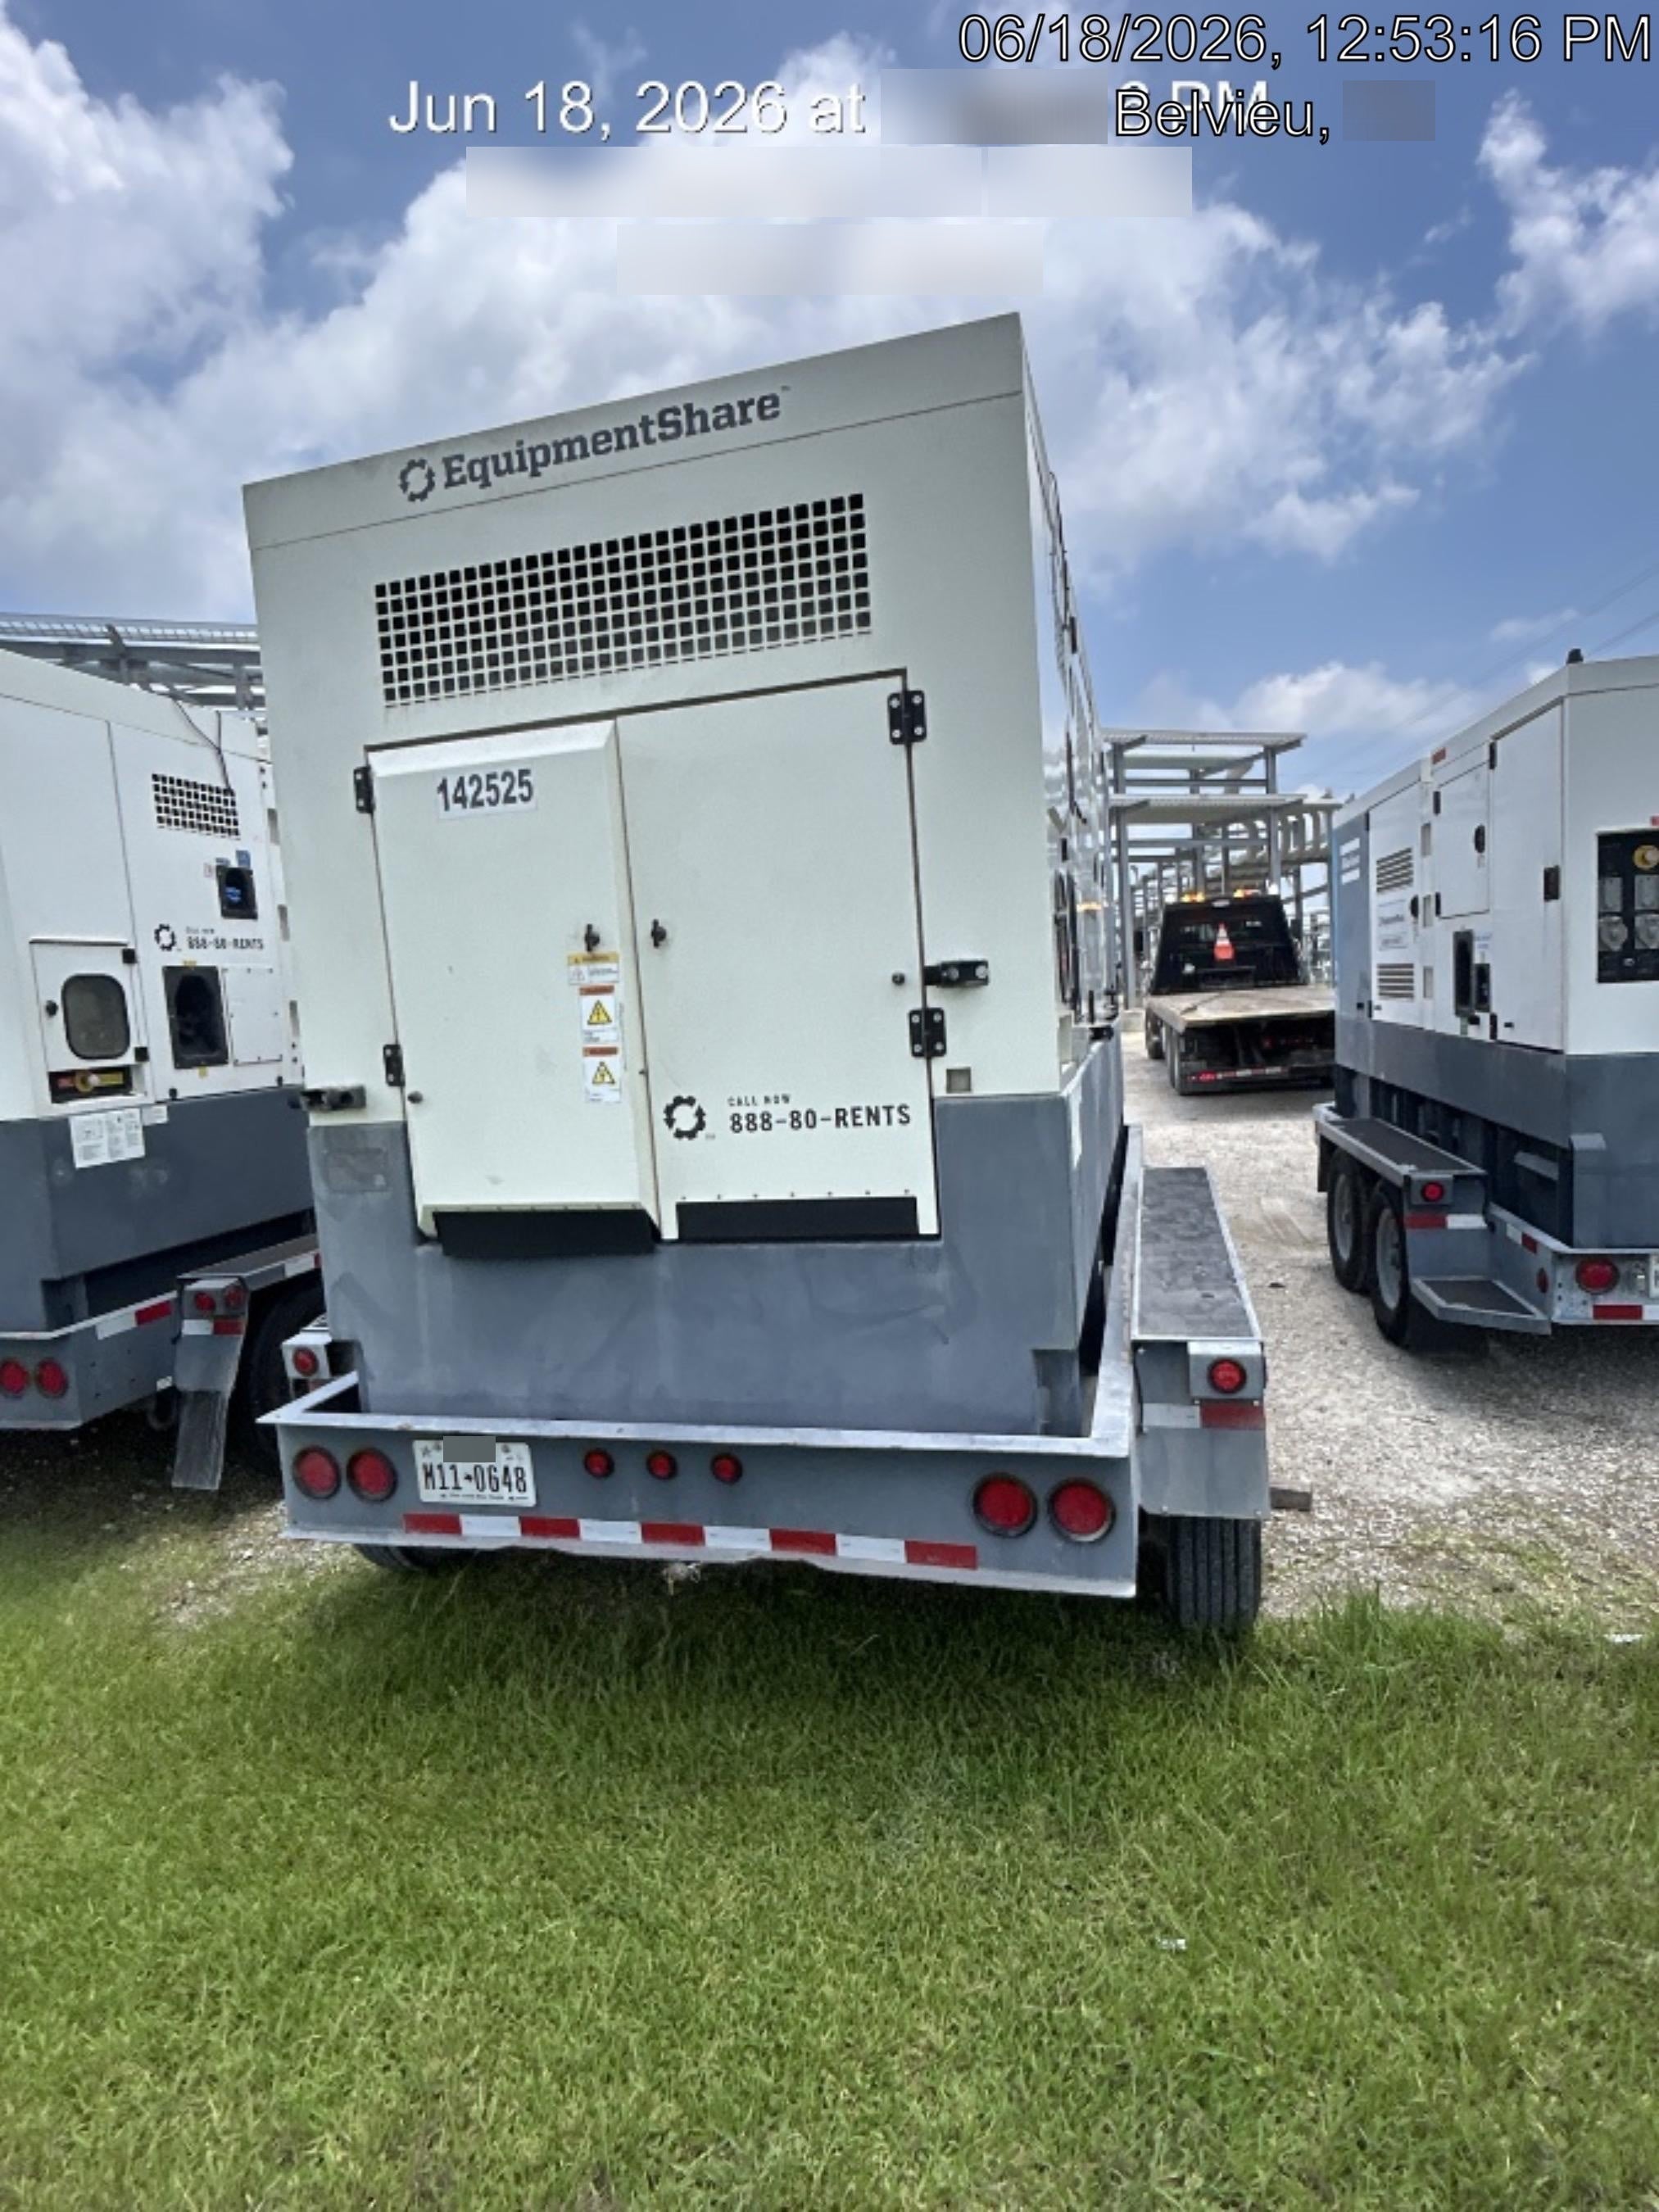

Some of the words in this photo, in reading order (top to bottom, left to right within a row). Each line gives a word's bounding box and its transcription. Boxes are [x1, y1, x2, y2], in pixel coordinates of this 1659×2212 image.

[442, 392, 782, 490] EquipmentShare
[437, 768, 533, 812] 142525
[729, 1104, 911, 1134] 888-80-RENTS
